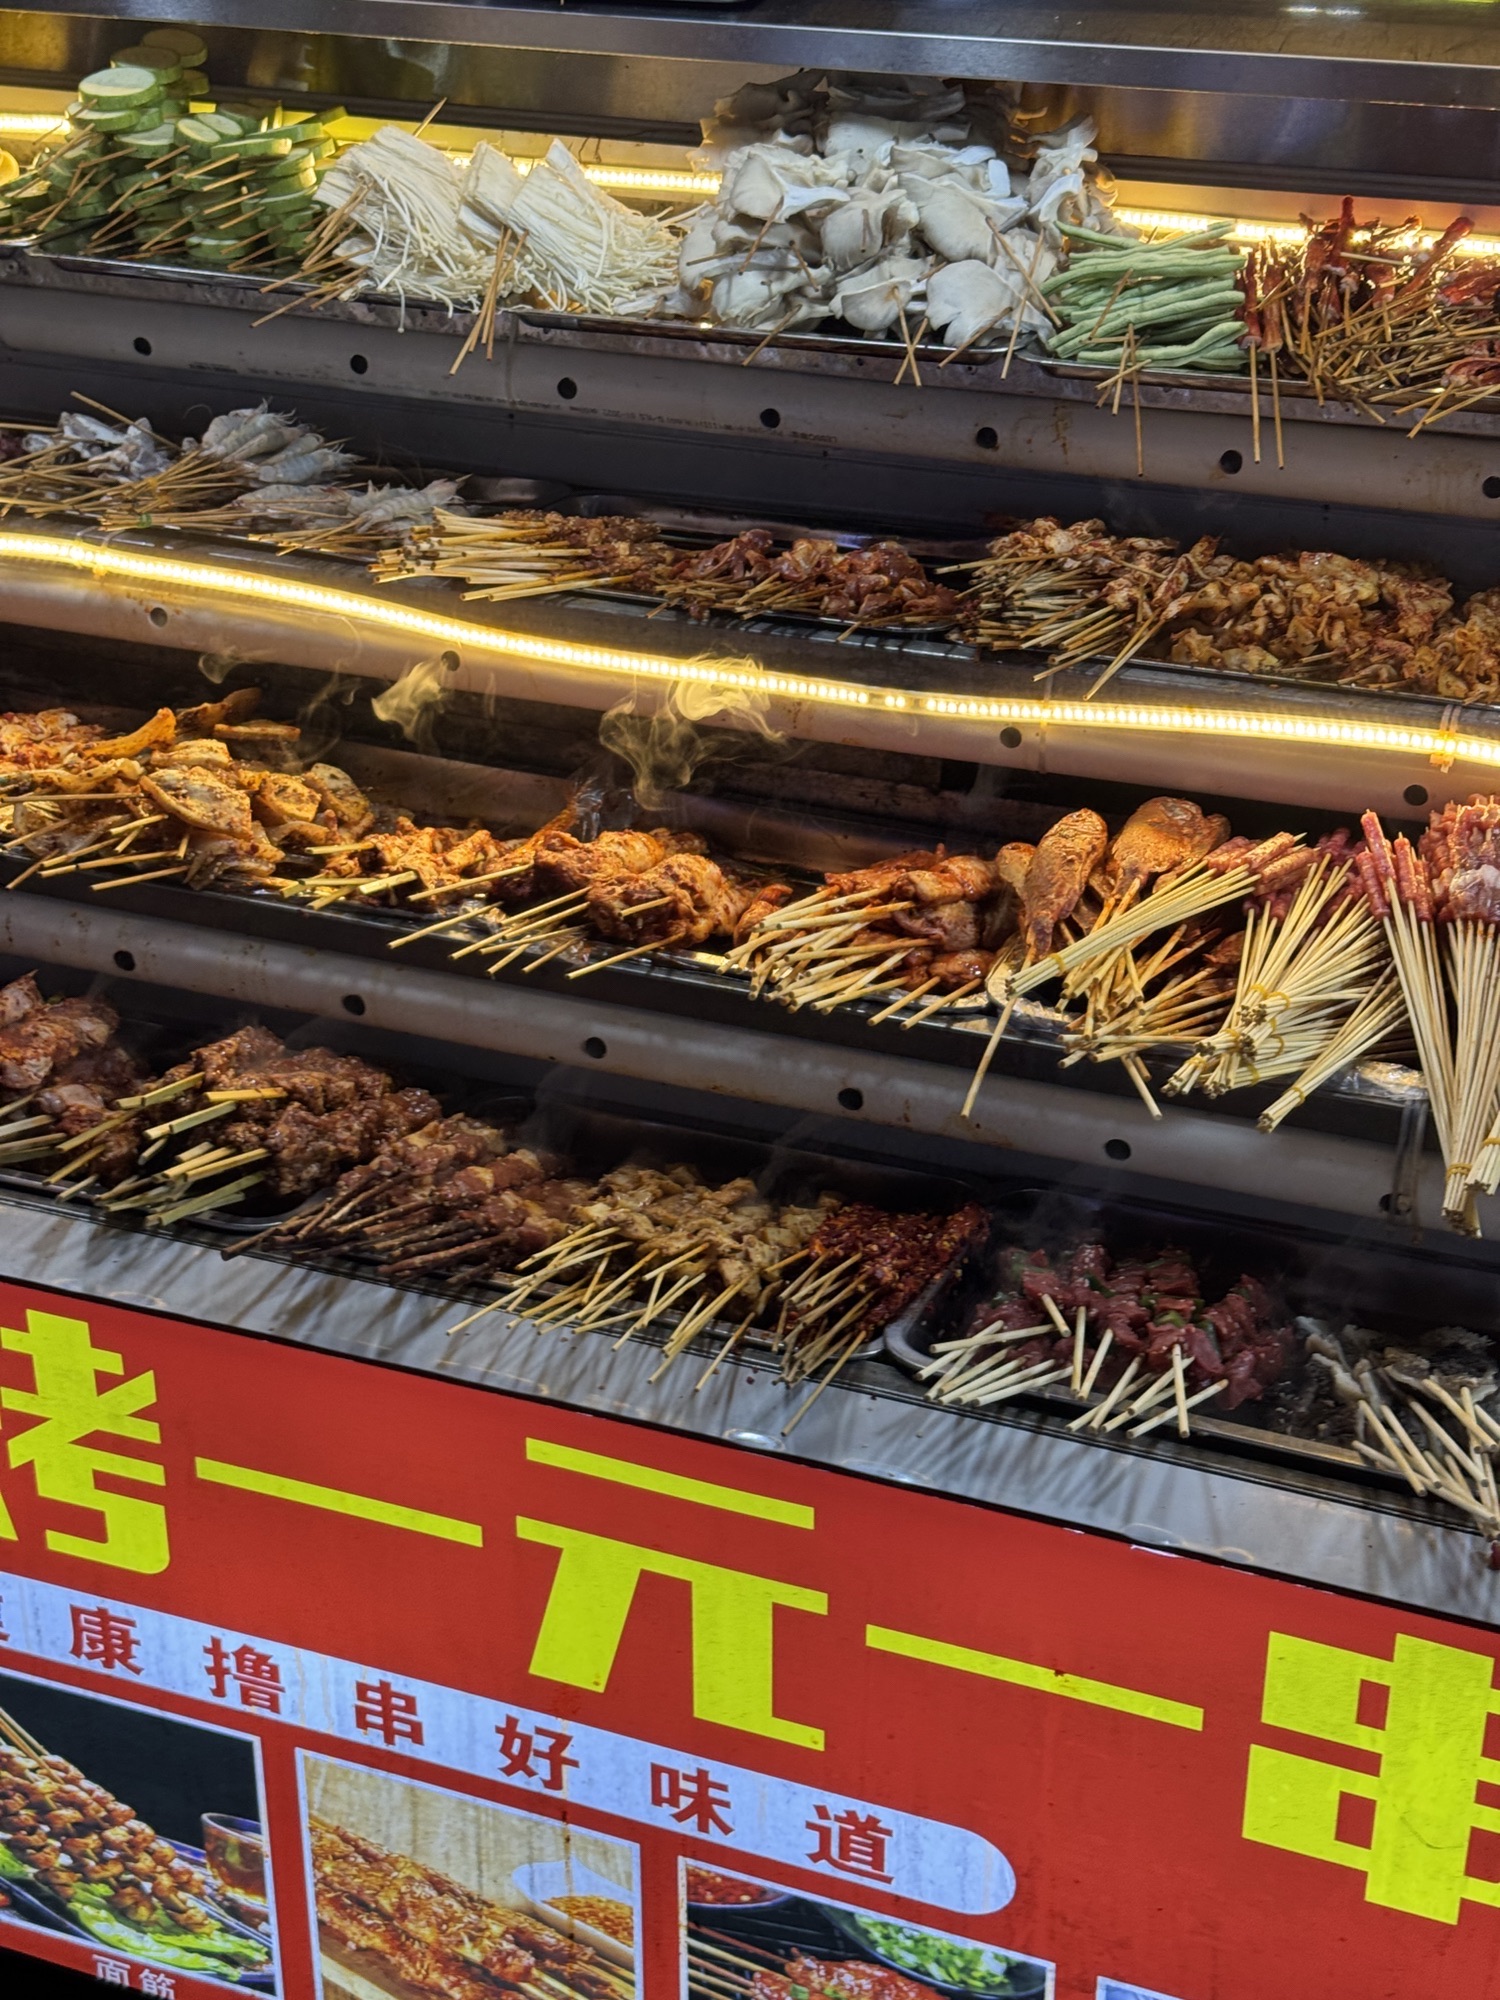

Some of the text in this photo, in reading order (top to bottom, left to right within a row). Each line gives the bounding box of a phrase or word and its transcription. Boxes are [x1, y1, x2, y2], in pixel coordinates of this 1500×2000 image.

[0, 1309, 1500, 1925] 烤一元一串
[0, 1595, 894, 1885] 康撸串好味道
[92, 1954, 176, 2000] 面筋
